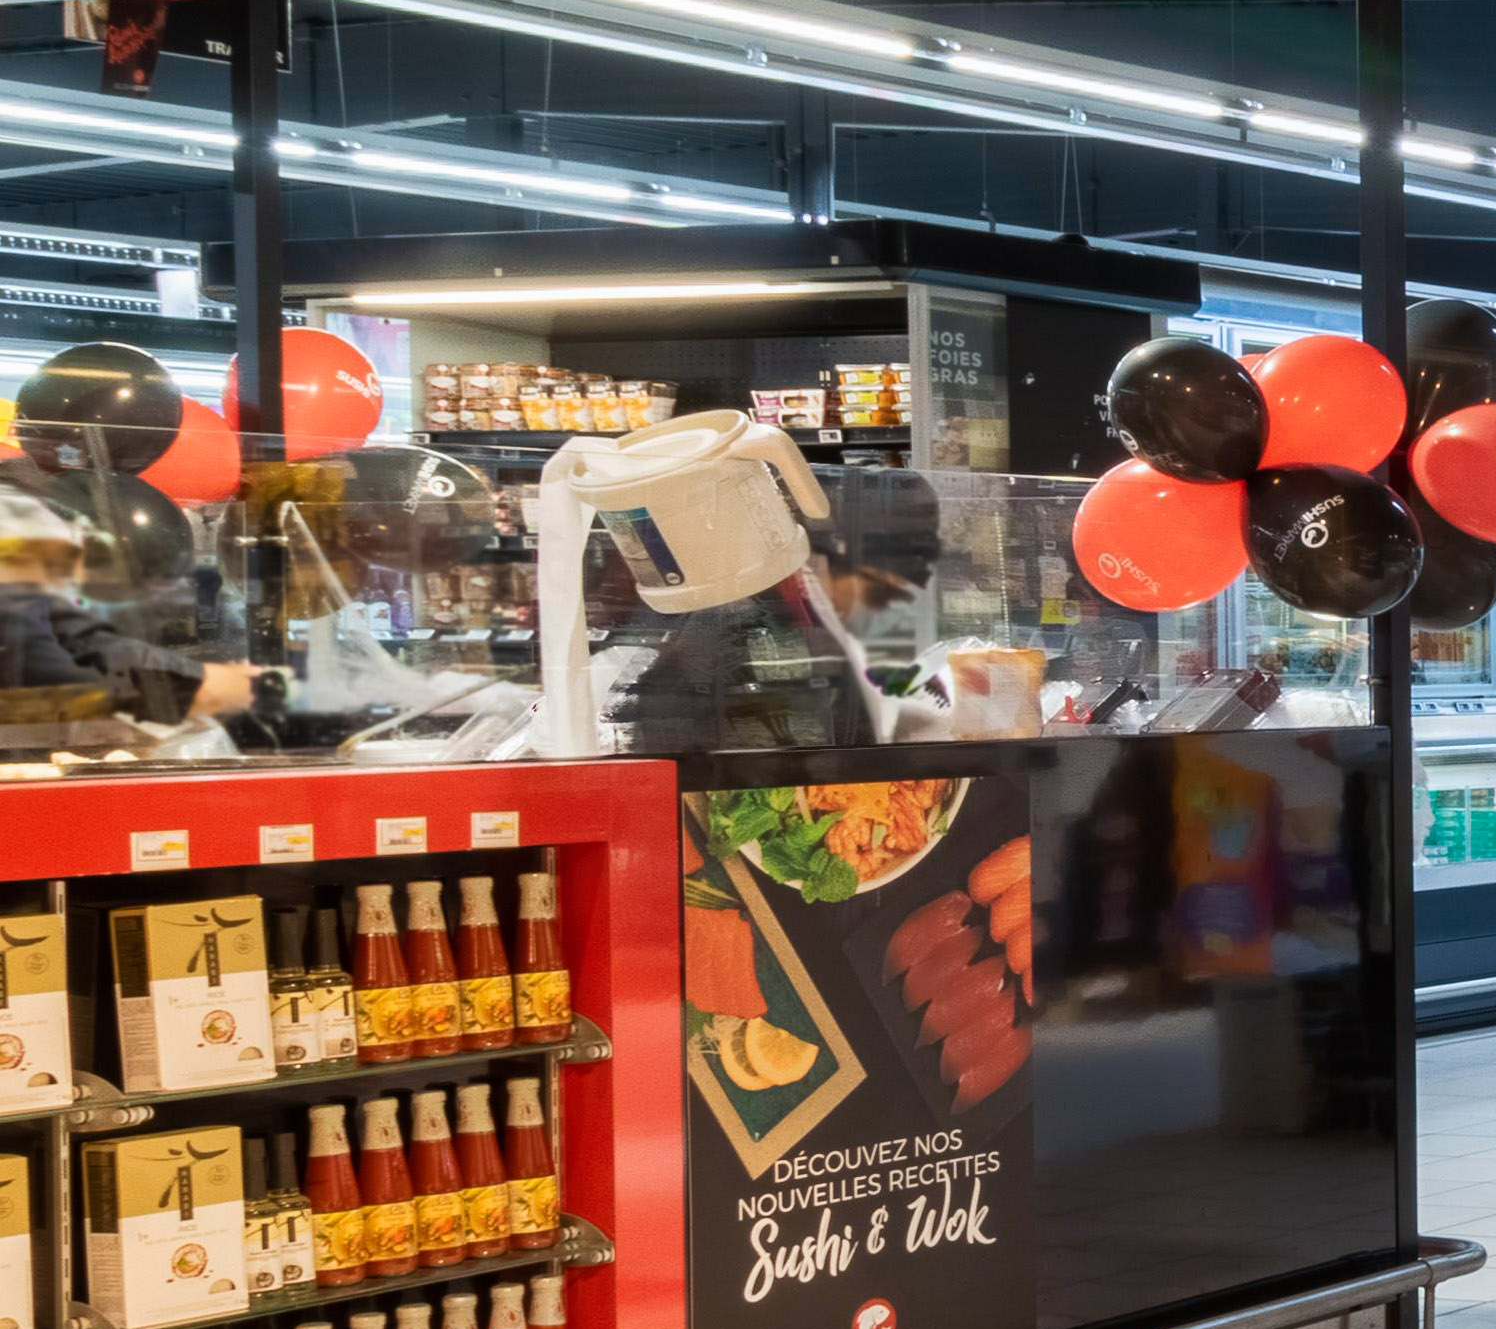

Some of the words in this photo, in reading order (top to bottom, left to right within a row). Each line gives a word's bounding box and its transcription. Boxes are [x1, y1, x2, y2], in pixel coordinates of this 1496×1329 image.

[929, 351, 982, 368] FOIES
[929, 368, 979, 386] GRAS
[774, 1138, 908, 1184] DÉCOUVEZ
[914, 1129, 963, 1157] NOS
[737, 1174, 882, 1222] NOUVELLES
[888, 1151, 1001, 1192] RECETTES
[743, 1208, 859, 1303] Sushi
[905, 1169, 997, 1254] Wok
